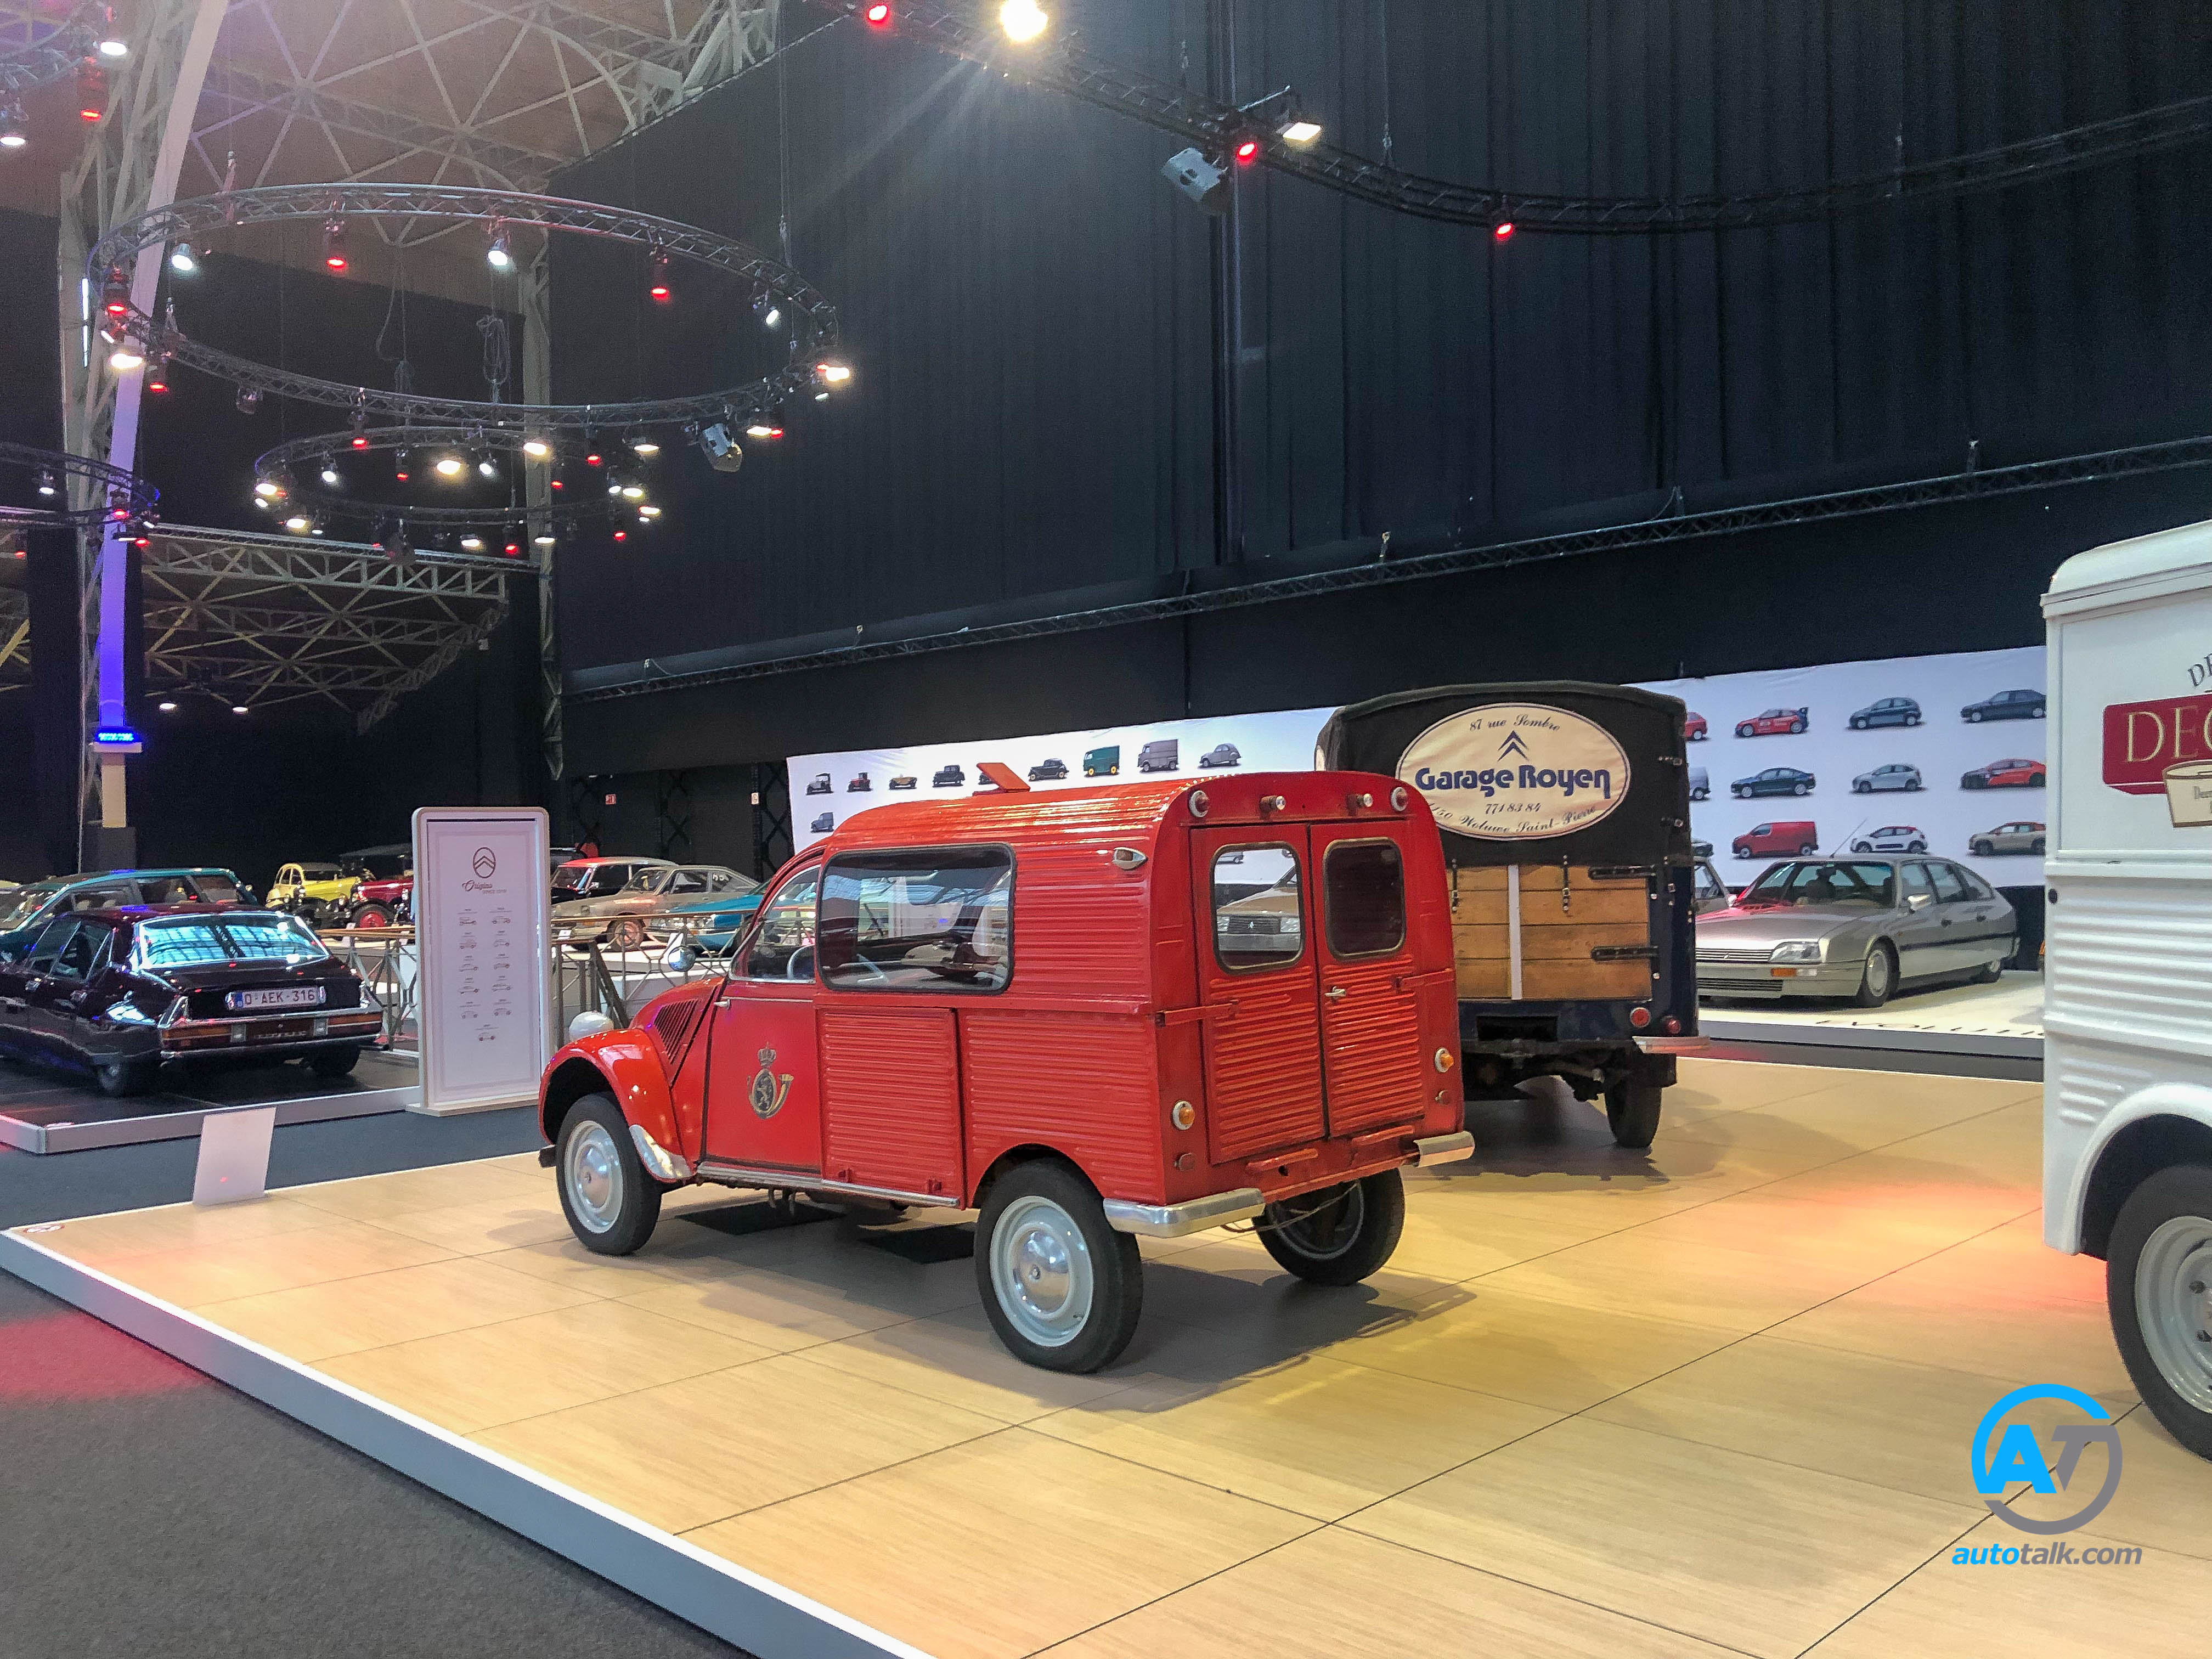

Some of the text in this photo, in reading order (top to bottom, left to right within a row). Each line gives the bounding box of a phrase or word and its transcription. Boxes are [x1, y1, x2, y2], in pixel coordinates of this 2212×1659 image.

[1487, 719, 1506, 729] rue
[2125, 705, 2212, 763] DE
[1415, 764, 1611, 799] Garage Royen
